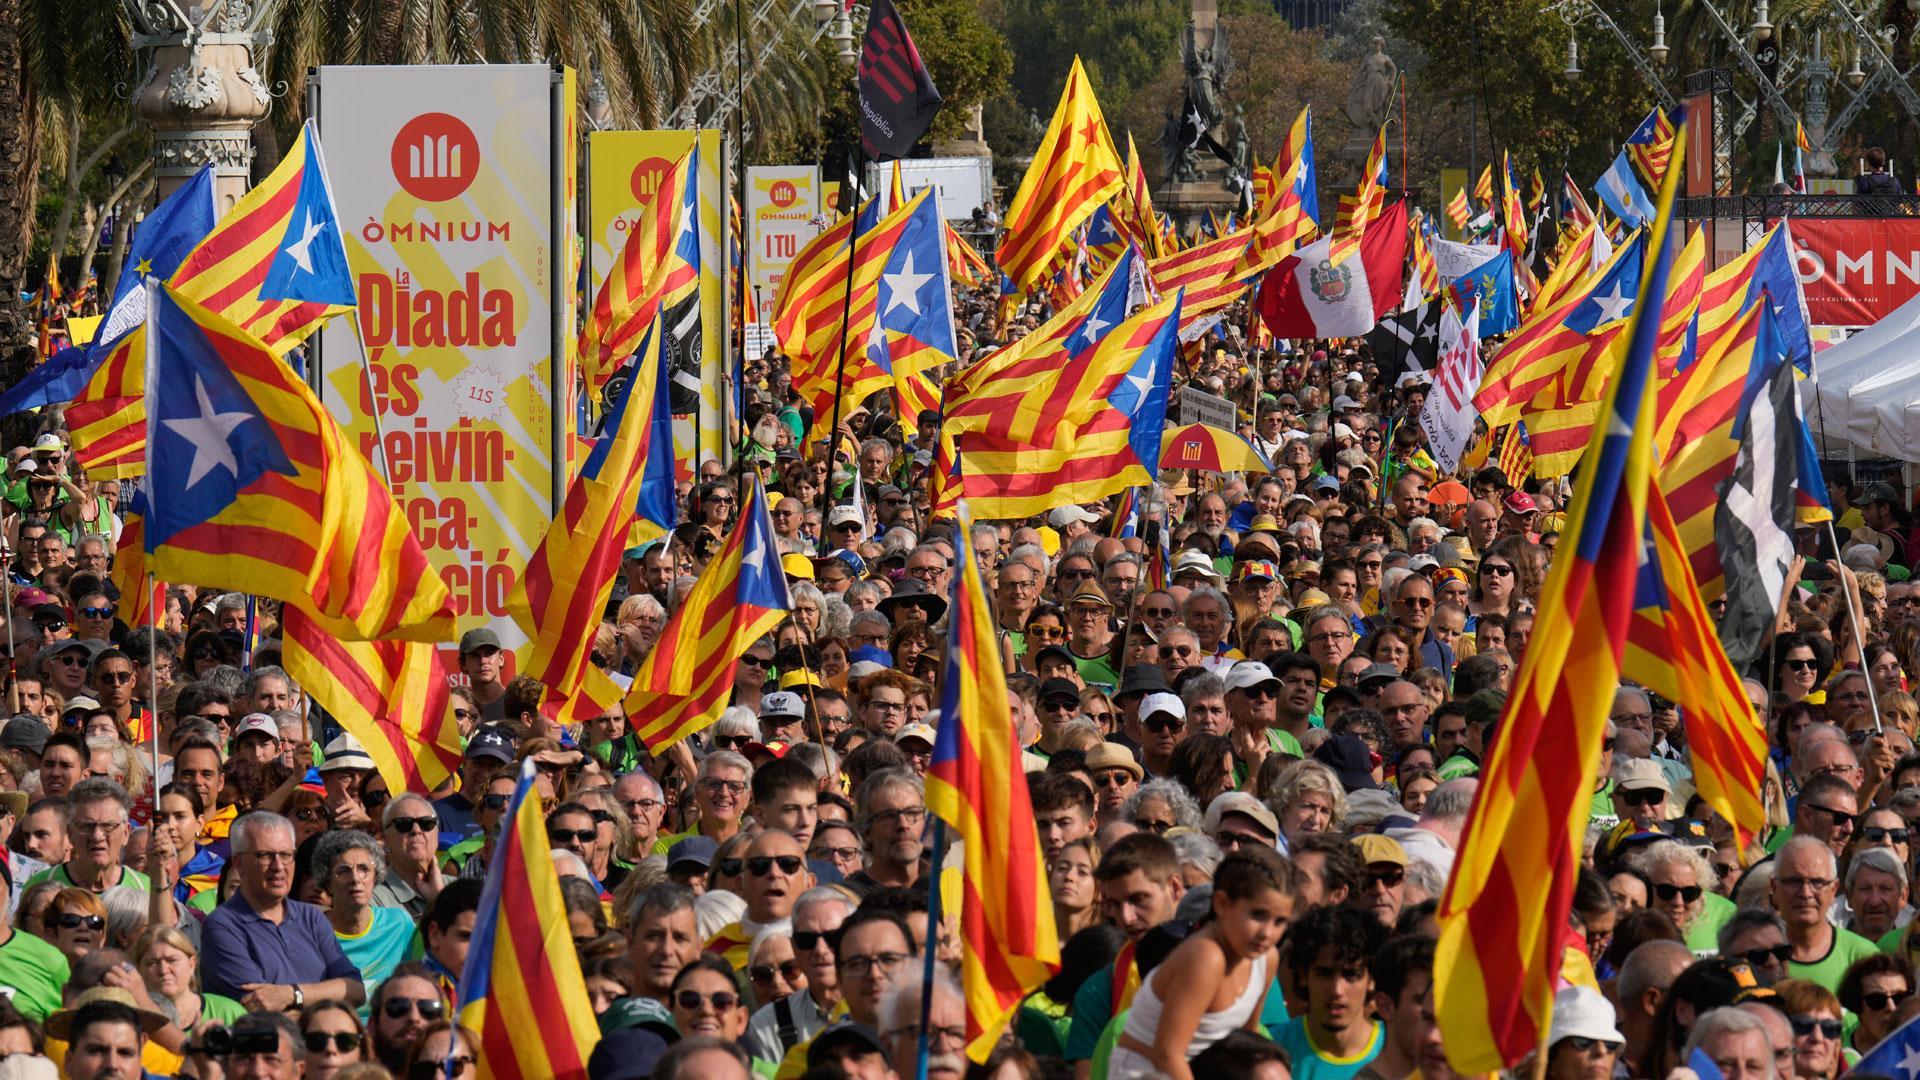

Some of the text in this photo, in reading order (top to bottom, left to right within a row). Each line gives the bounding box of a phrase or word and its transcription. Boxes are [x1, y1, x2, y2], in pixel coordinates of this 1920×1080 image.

[862, 100, 894, 139] República
[362, 216, 510, 243] ÒMNIUM
[774, 235, 796, 258] TU
[396, 268, 410, 285] La
[1795, 239, 1920, 285] ÒMN
[359, 272, 516, 347] Diada
[1864, 295, 1878, 303] PAÍS
[359, 348, 419, 417] és
[468, 386, 494, 404] 11S
[1422, 404, 1438, 443] nardó
[440, 548, 516, 617] ció
